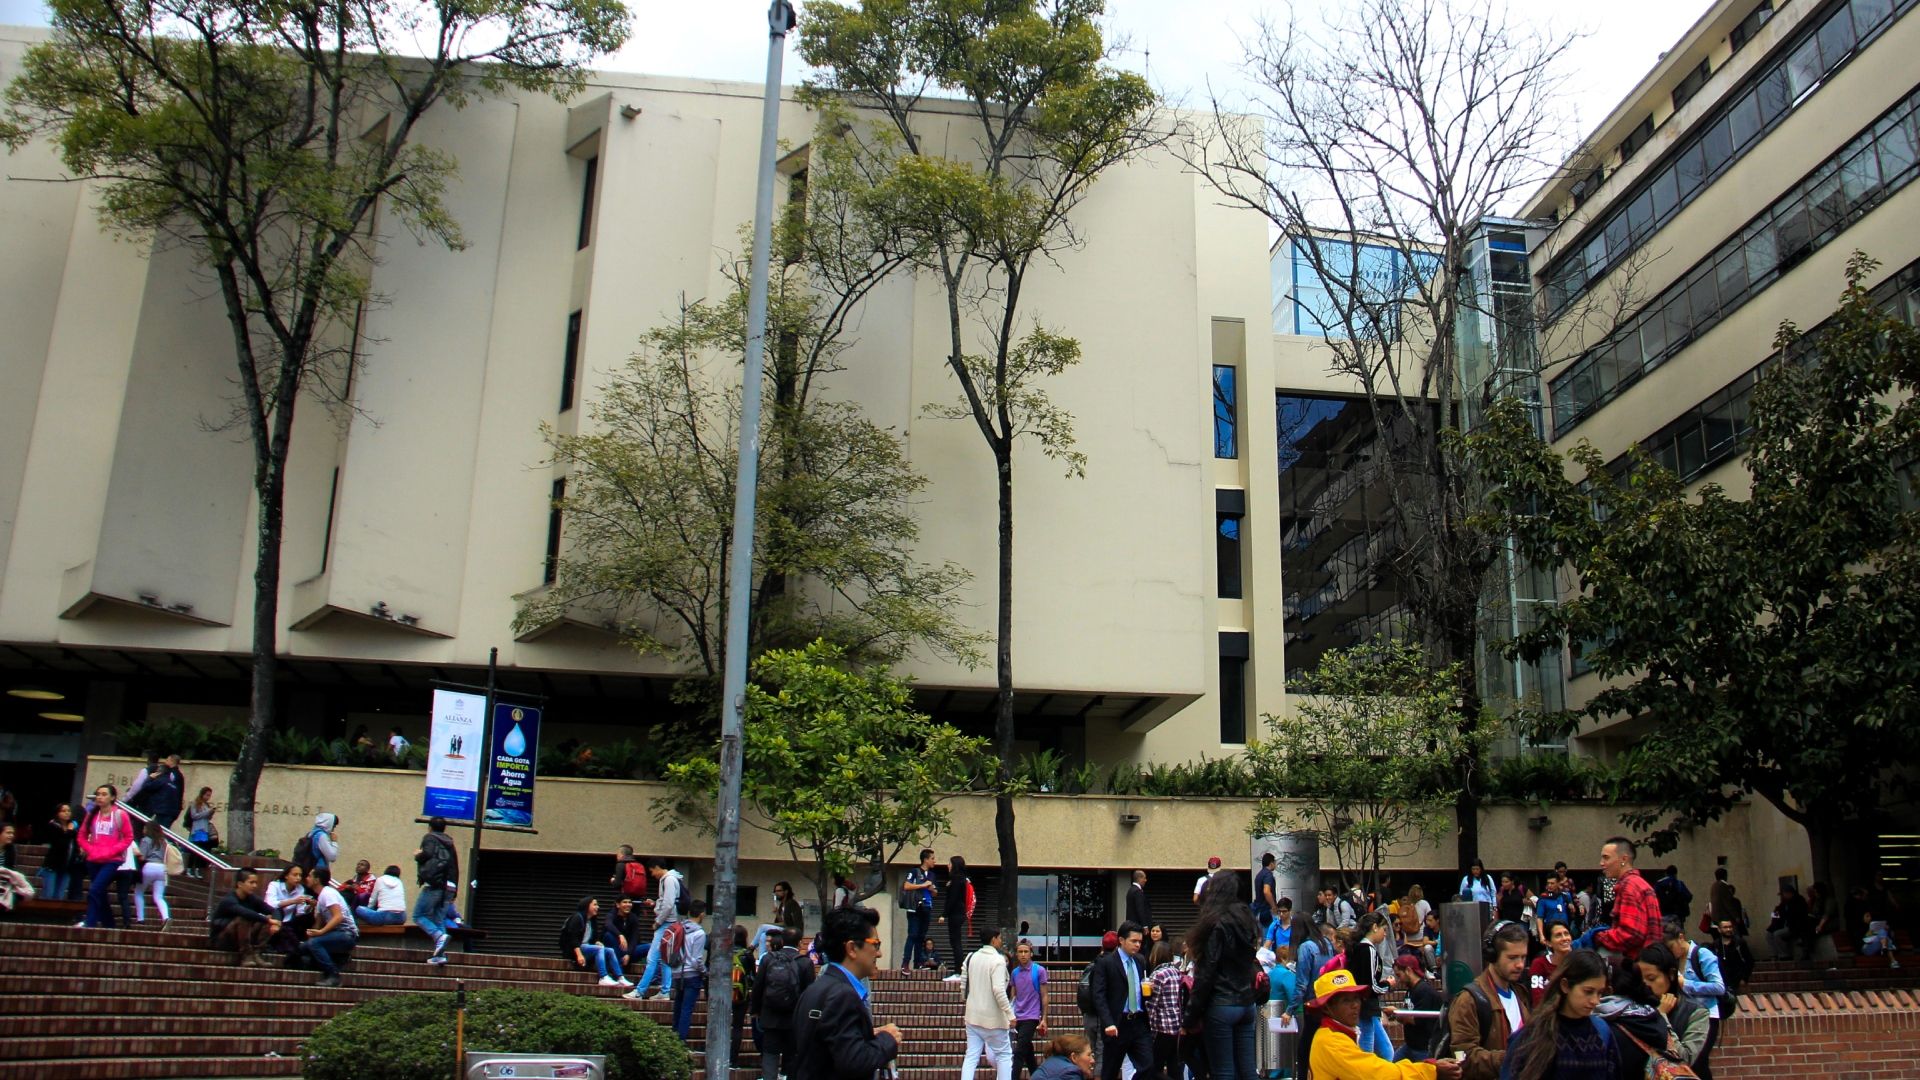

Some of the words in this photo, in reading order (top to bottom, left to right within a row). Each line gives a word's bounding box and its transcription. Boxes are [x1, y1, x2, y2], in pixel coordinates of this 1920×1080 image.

[445, 715, 472, 723] ALIANZA
[497, 755, 513, 763] CADA
[496, 761, 529, 771] IMPORTA
[503, 777, 522, 786] Agua
